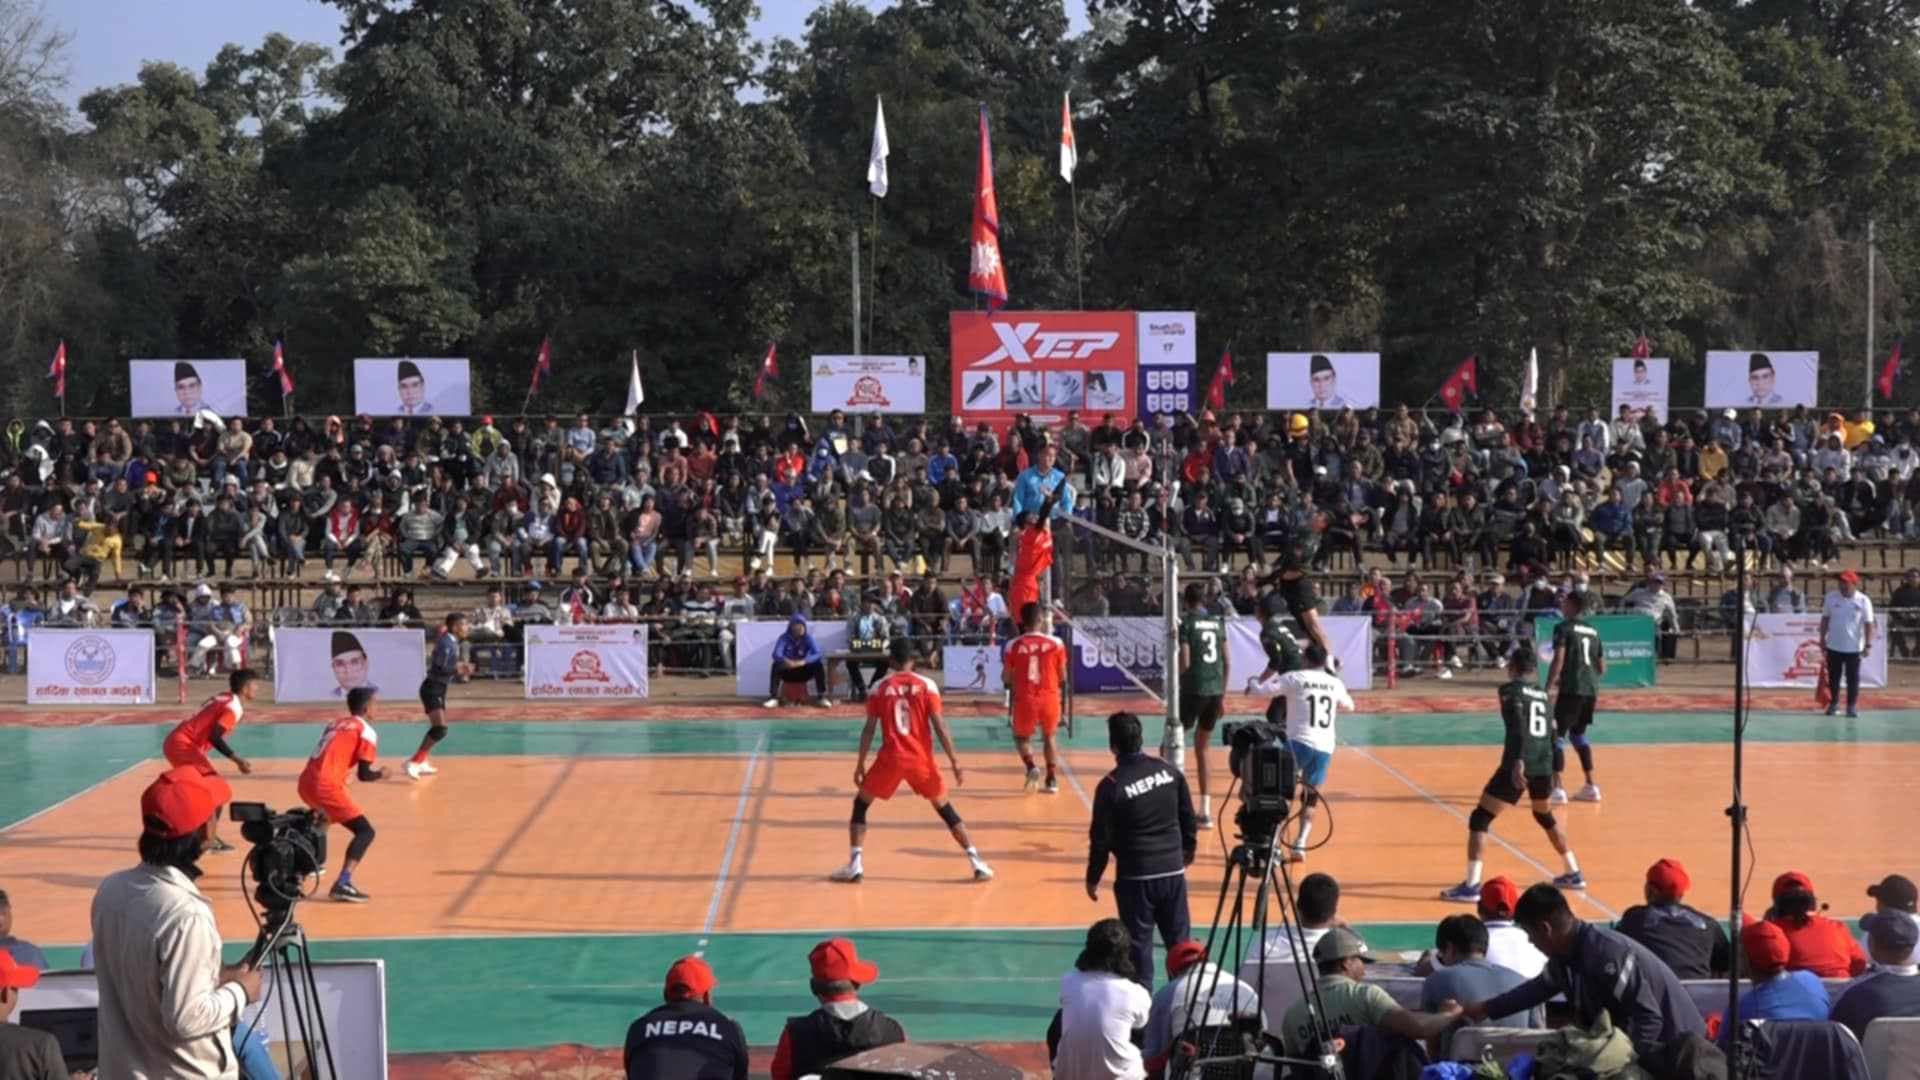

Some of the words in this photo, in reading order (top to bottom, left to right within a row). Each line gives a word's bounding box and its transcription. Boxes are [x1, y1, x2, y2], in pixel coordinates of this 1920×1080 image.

[969, 322, 1121, 367] XTEP
[1201, 631, 1217, 664] 3
[1581, 636, 1591, 666] 1
[1306, 694, 1332, 729] 13
[1529, 701, 1547, 737] 6
[1124, 769, 1175, 799] NEPAL
[644, 1020, 723, 1040] NEPAL
